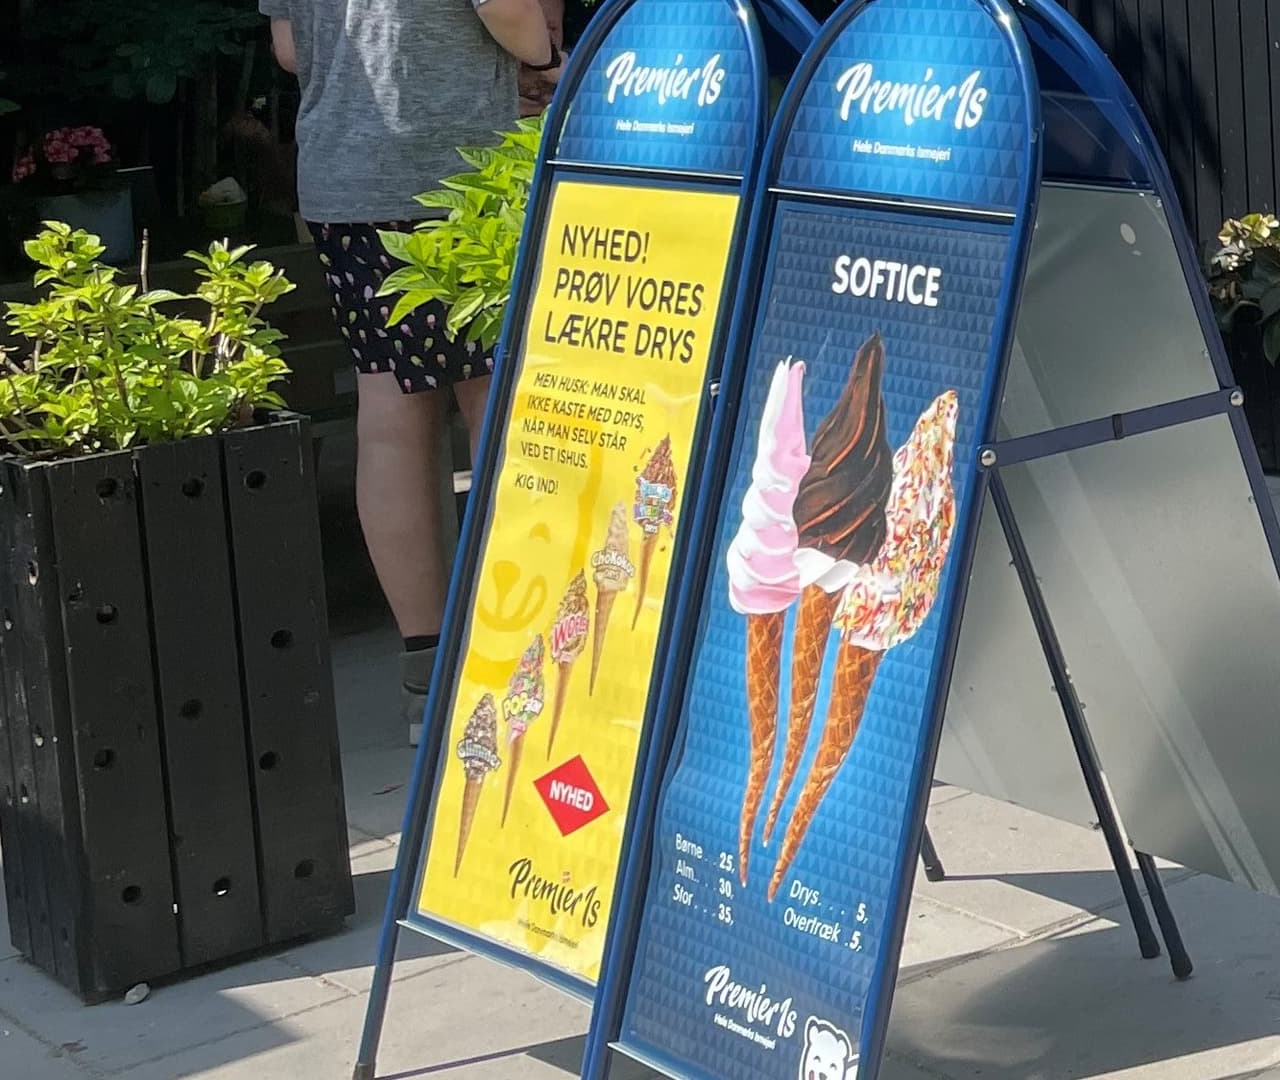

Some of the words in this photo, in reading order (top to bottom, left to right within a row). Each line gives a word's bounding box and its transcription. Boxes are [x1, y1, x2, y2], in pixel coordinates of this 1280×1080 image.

[606, 50, 699, 105] Premier
[697, 52, 725, 107] Is
[836, 62, 955, 126] Premier
[953, 70, 989, 129] Is
[853, 139, 872, 153] Hele
[874, 141, 916, 157] Danmarks
[917, 146, 950, 161] Ismejeri
[561, 224, 650, 264] NYHED!
[554, 268, 620, 306] PRØV
[627, 275, 705, 317] VORES
[831, 254, 944, 309] SOFTICE
[544, 311, 629, 353] LÆKRE
[635, 323, 696, 364] DRYS
[534, 372, 556, 389] MEN
[559, 376, 588, 395] HUSK:
[591, 383, 617, 399] MAN
[619, 386, 647, 405] SKAL
[527, 395, 551, 412] IKKE
[552, 399, 584, 419] KASTE
[587, 405, 612, 423] MED
[613, 409, 645, 432] DRYS,
[522, 416, 545, 433] NÅR
[547, 423, 569, 440] MAN
[571, 427, 599, 446] SELV
[599, 430, 627, 451] STÅR
[521, 441, 544, 458] VED
[543, 445, 555, 460] ET
[557, 448, 588, 469] ISHUS.
[514, 473, 534, 490] KIG
[536, 477, 559, 495] IND!
[549, 779, 594, 812] NYHED
[675, 833, 703, 859] Børne
[508, 857, 583, 915] Premier
[582, 886, 601, 928] Is
[672, 884, 695, 906] Stor
[783, 907, 842, 943] Overtræk
[703, 964, 779, 1026] Premier
[776, 997, 797, 1038] Is
